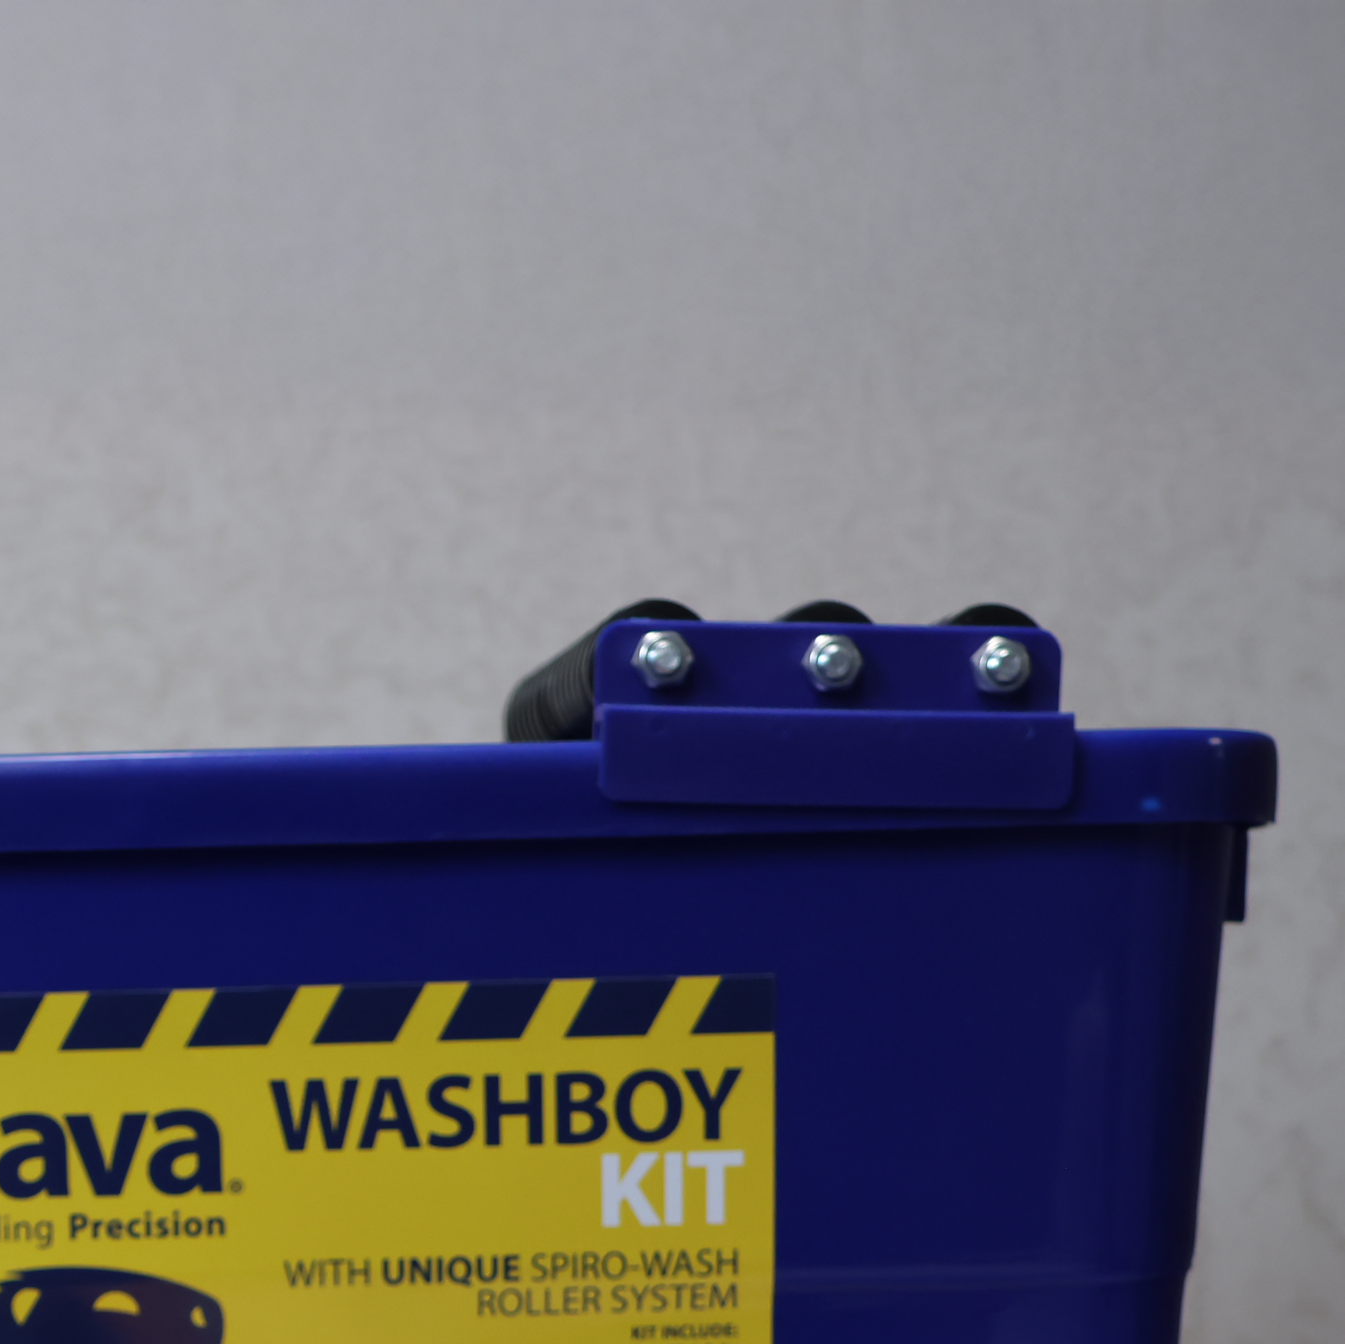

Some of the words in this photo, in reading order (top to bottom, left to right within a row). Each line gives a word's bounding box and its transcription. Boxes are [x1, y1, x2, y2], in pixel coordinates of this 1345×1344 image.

[269, 1067, 743, 1152] WASHBOY
[601, 1150, 744, 1228] KIT
[68, 1210, 227, 1241] Precision
[283, 1257, 373, 1288] WITH
[381, 1253, 522, 1286] UNIQUE
[531, 1248, 740, 1283] SPIRO-WASH
[477, 1283, 602, 1318] ROLLER
[611, 1282, 740, 1315] SYSTEM
[630, 1325, 657, 1340] KIT
